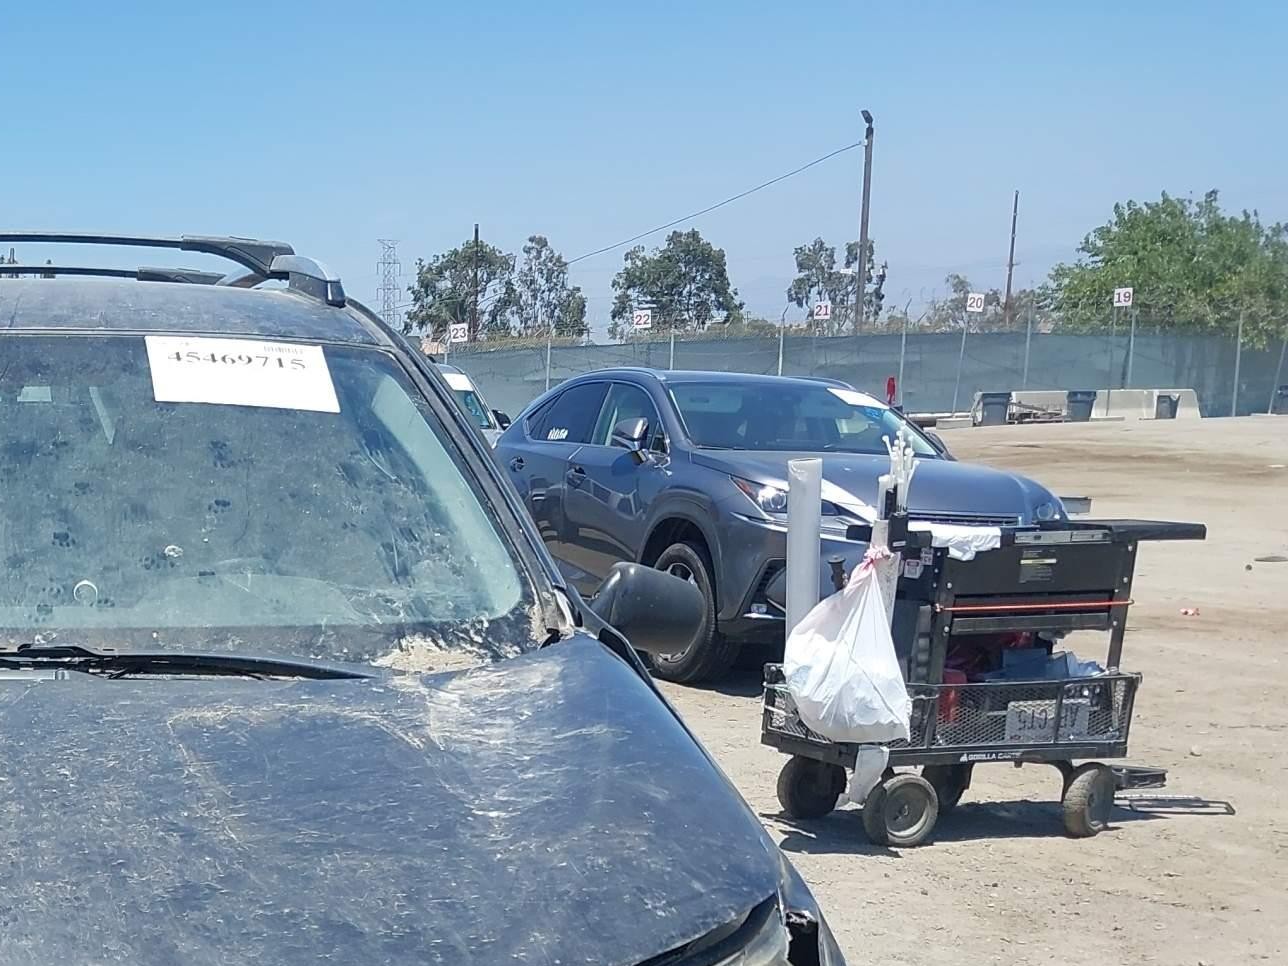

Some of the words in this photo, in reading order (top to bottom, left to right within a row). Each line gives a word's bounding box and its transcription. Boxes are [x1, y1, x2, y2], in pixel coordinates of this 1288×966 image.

[968, 297, 983, 309] 20
[1114, 291, 1131, 303] 19
[814, 304, 830, 317] 21
[634, 313, 651, 326] 22
[451, 327, 467, 340] 23
[167, 350, 307, 370] 45469715
